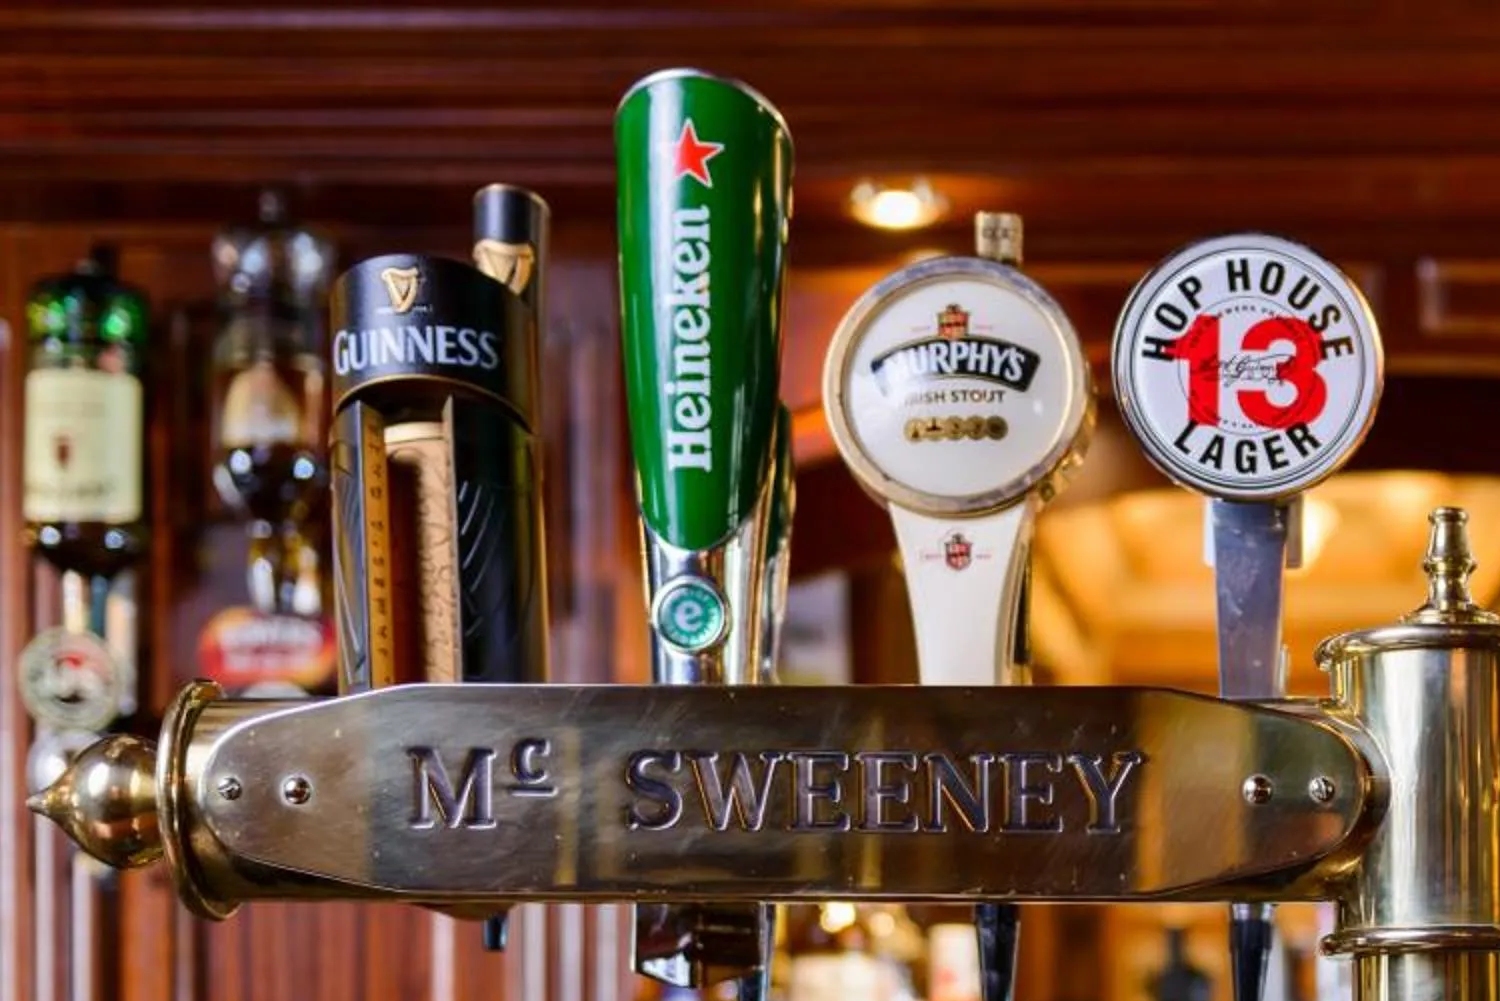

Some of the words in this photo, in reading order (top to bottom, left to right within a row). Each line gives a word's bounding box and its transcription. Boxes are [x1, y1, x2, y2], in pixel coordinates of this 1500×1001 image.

[665, 205, 712, 473] Heineken
[1141, 275, 1203, 362] HOP
[1226, 258, 1354, 360] HOUSE
[333, 325, 499, 376] GUINNESS
[1165, 313, 1328, 430] 13
[905, 390, 946, 407] ISH
[951, 389, 1007, 403] STOUT
[1173, 419, 1322, 475] LAGER
[622, 749, 1146, 834] SWEENEY
